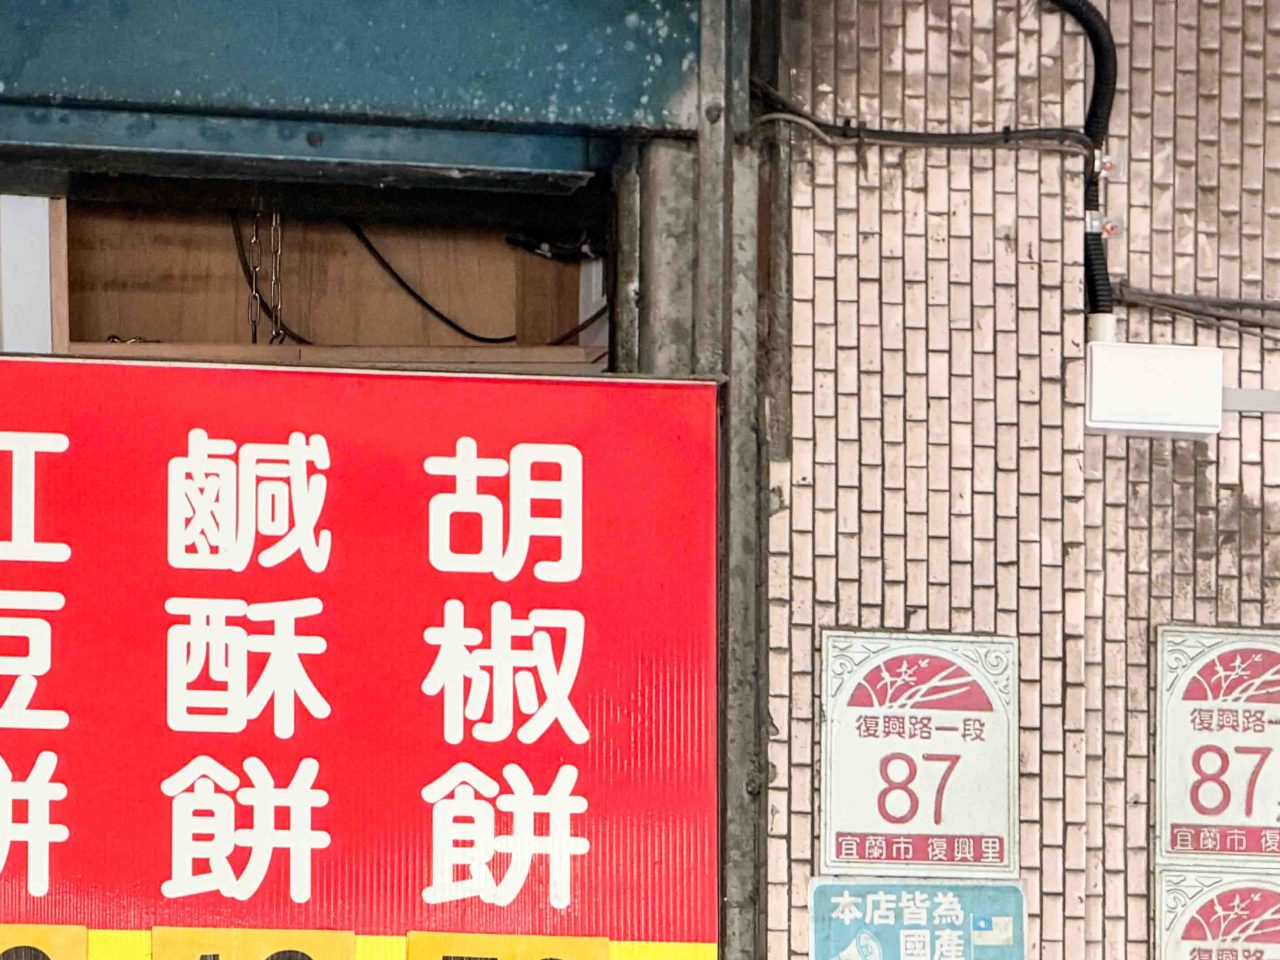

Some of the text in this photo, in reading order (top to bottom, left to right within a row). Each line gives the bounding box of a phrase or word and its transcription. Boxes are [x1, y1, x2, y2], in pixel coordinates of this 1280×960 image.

[161, 428, 332, 904] 鹹酥餅
[422, 436, 591, 914] 胡椒餅
[855, 715, 986, 742] 復興路一段
[877, 752, 961, 825] 87
[1190, 744, 1273, 817] 87
[838, 836, 1001, 862] 宜蘭市 復興里
[1174, 828, 1247, 851] 宜蘭市
[831, 890, 964, 926] 本店皆為
